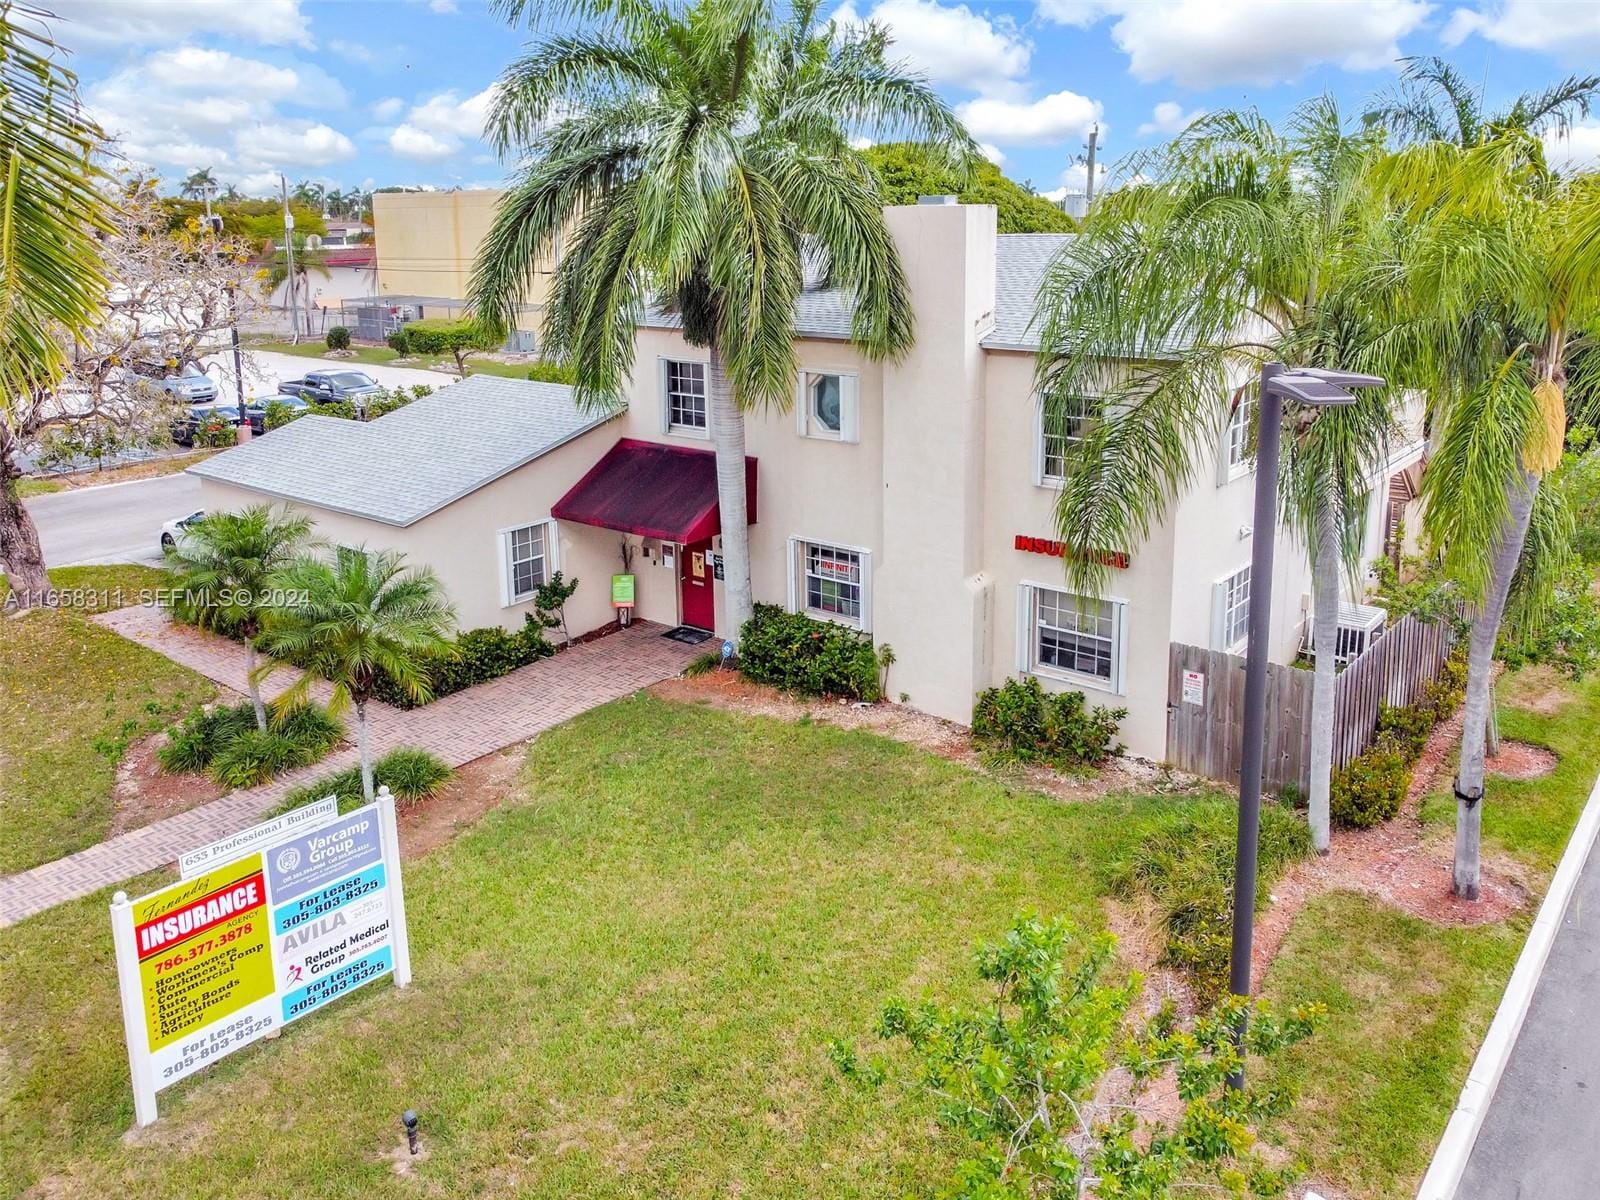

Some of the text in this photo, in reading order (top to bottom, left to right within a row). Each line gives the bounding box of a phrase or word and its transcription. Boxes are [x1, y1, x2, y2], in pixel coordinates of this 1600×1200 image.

[212, 821, 282, 856] Professional
[287, 802, 332, 826] Building
[307, 820, 370, 852] Varcamp
[309, 838, 354, 863] Group
[142, 877, 210, 923] Fernandez
[282, 879, 378, 929] 305-803-8325
[299, 877, 361, 911] For Lease
[141, 882, 258, 952] INSURANCE
[226, 910, 260, 929] AGENCY
[282, 911, 347, 954] AVILA
[154, 923, 253, 975] 786.377.3878
[304, 919, 390, 967] Related Medical
[310, 953, 346, 975] Group
[155, 946, 238, 989] Homeowners
[156, 943, 264, 996] Workmen's Comp
[157, 963, 235, 1005] Commercial
[289, 961, 385, 1015] 305-803-8325
[306, 960, 368, 996] For Lease
[158, 996, 187, 1013] Auto
[159, 978, 240, 1022] Surety Bonds
[160, 991, 232, 1030] Agriculture
[161, 1012, 204, 1038] Notary
[162, 1015, 273, 1078] 305-803-8325
[182, 1015, 254, 1057] For Lease
